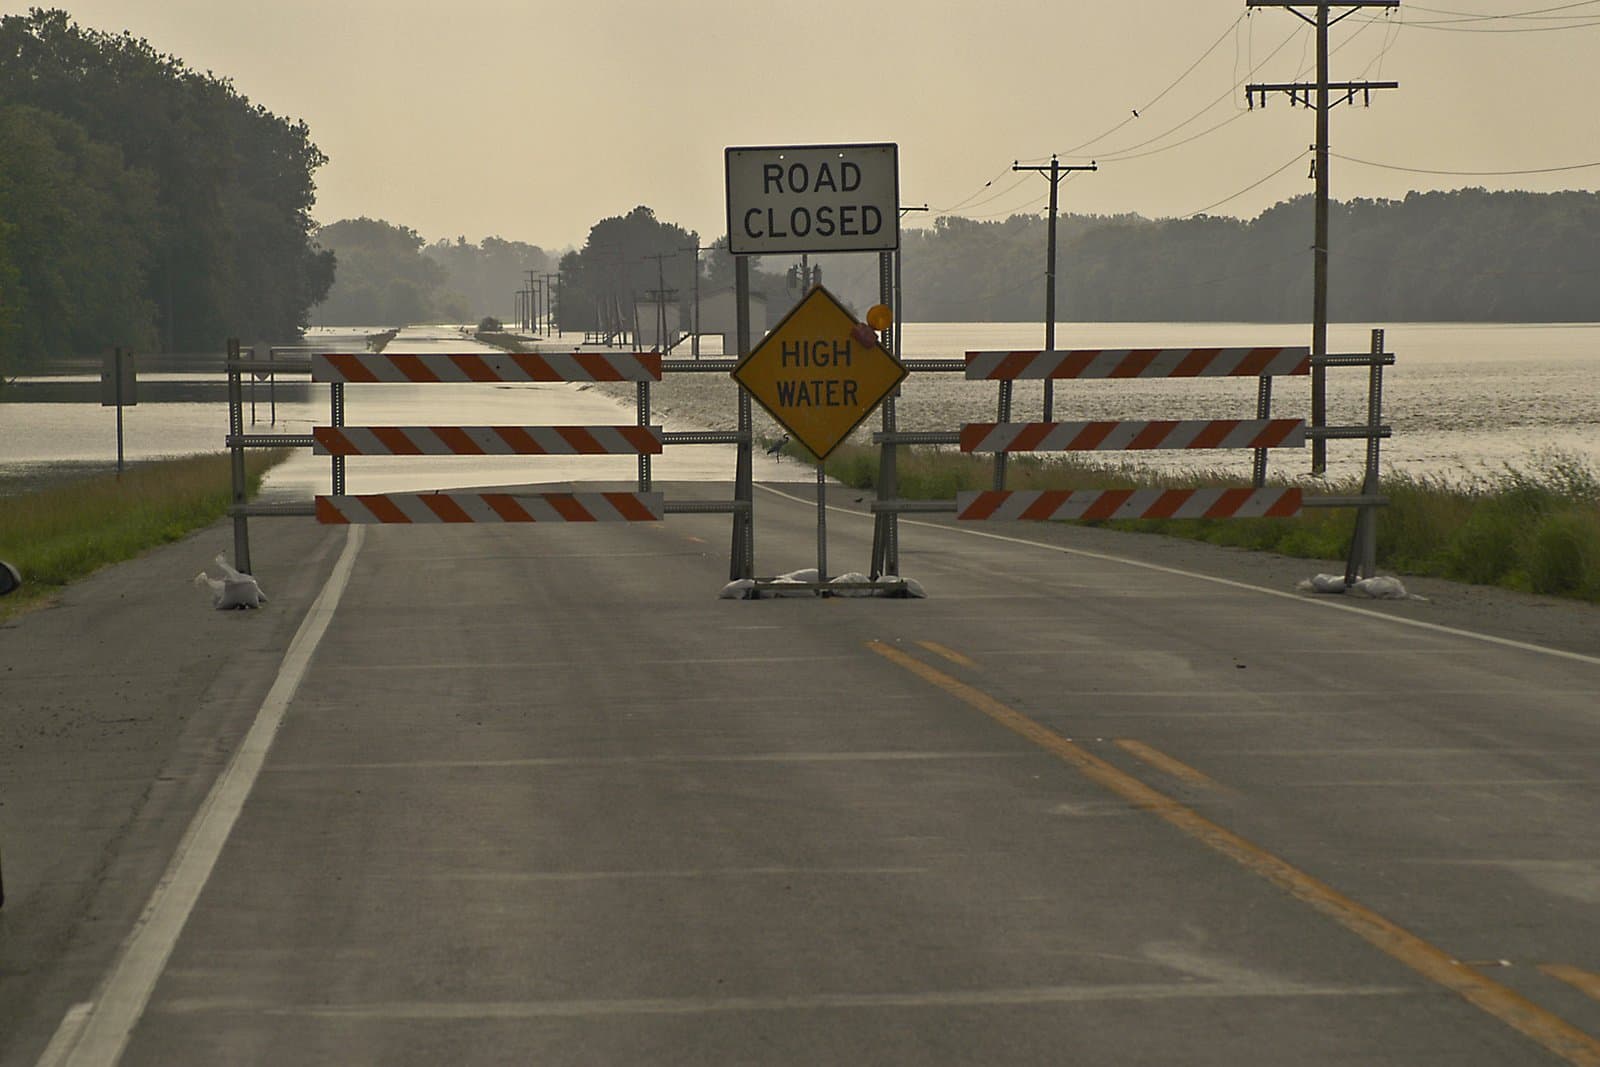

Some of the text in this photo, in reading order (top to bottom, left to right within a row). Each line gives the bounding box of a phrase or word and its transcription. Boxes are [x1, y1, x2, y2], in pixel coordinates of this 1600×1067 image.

[763, 162, 861, 193] ROAD
[744, 205, 882, 239] CLOSED
[782, 340, 850, 368] HIGH
[777, 380, 858, 407] WATER
